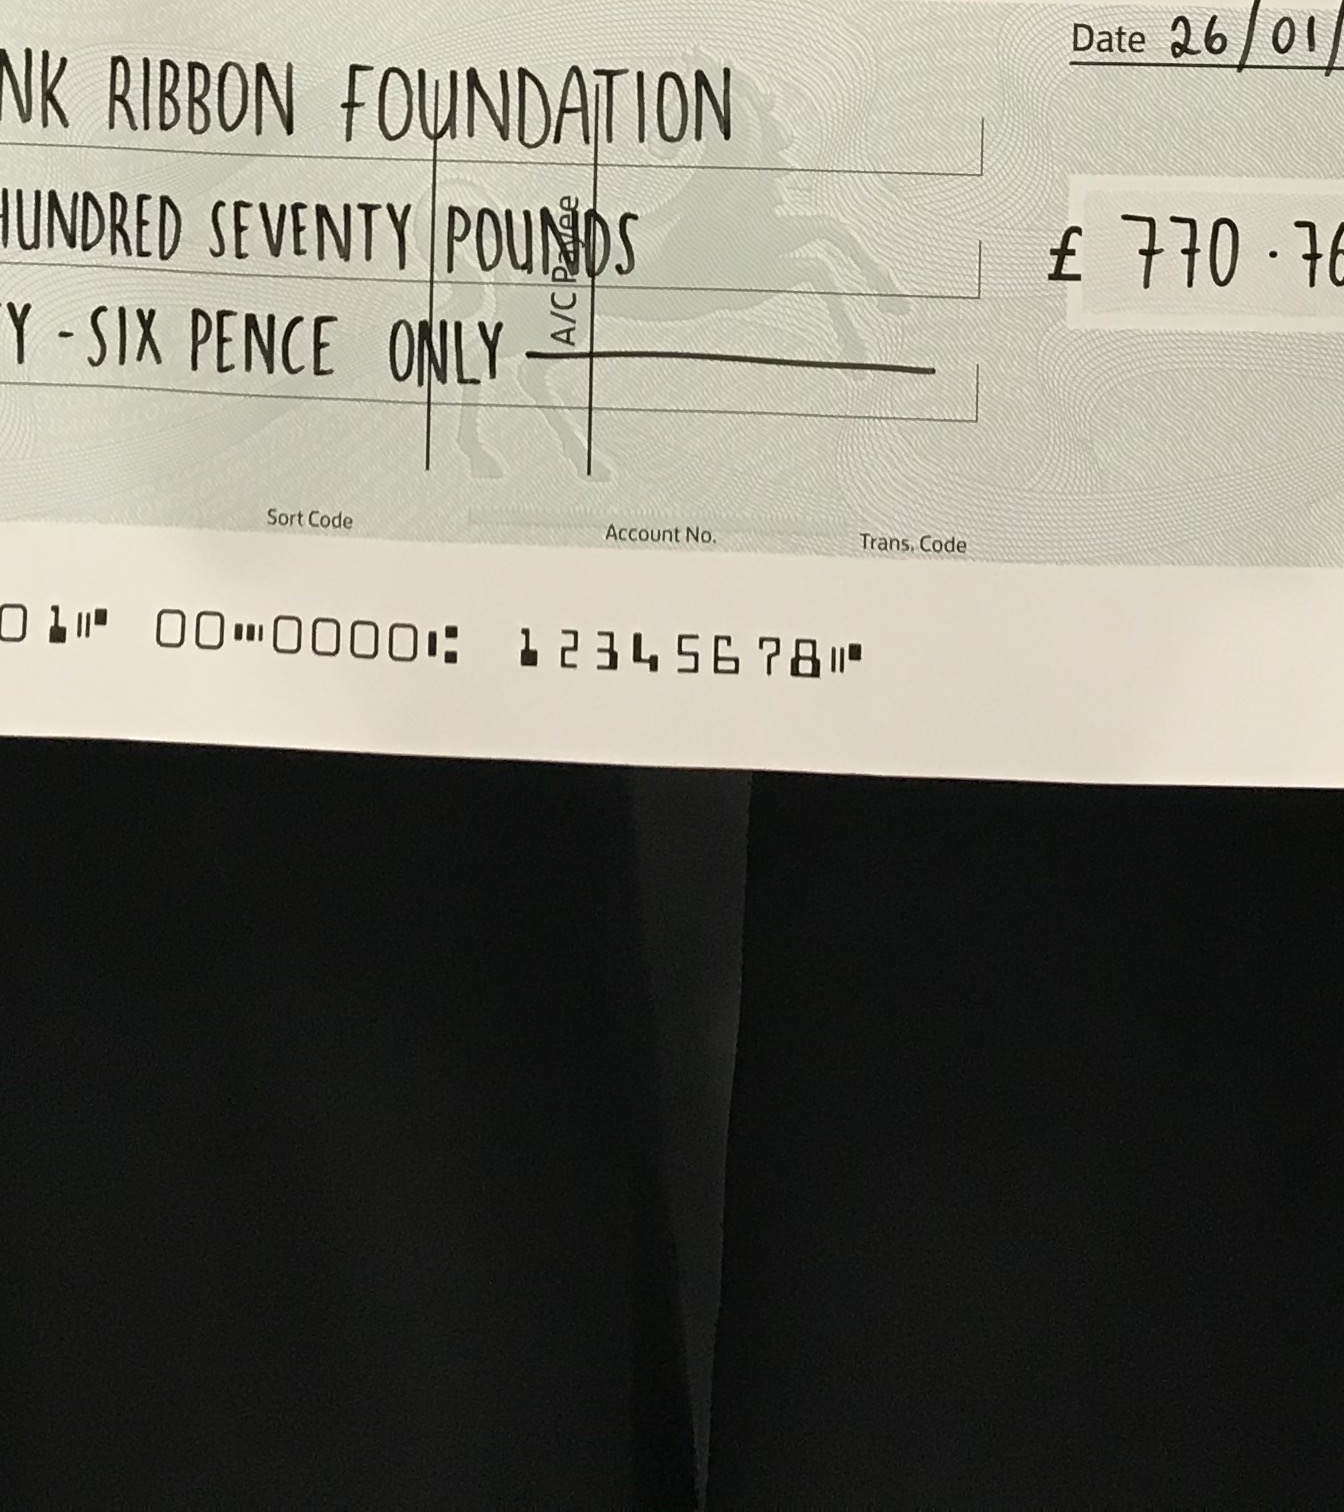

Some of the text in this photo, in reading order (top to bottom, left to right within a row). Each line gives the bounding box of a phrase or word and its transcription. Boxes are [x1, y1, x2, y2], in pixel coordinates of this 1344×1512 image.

[1072, 23, 1147, 54] Date
[109, 54, 295, 136] RIBBON
[341, 63, 732, 149] FOUNDATION
[209, 199, 412, 270] SEVENTY
[447, 204, 640, 279] POUNDS
[191, 307, 339, 376] PENCE
[389, 319, 504, 387] ONLY
[266, 508, 354, 530] Sort Code
[605, 523, 718, 544] Account No.
[858, 533, 968, 555] Trans. Code
